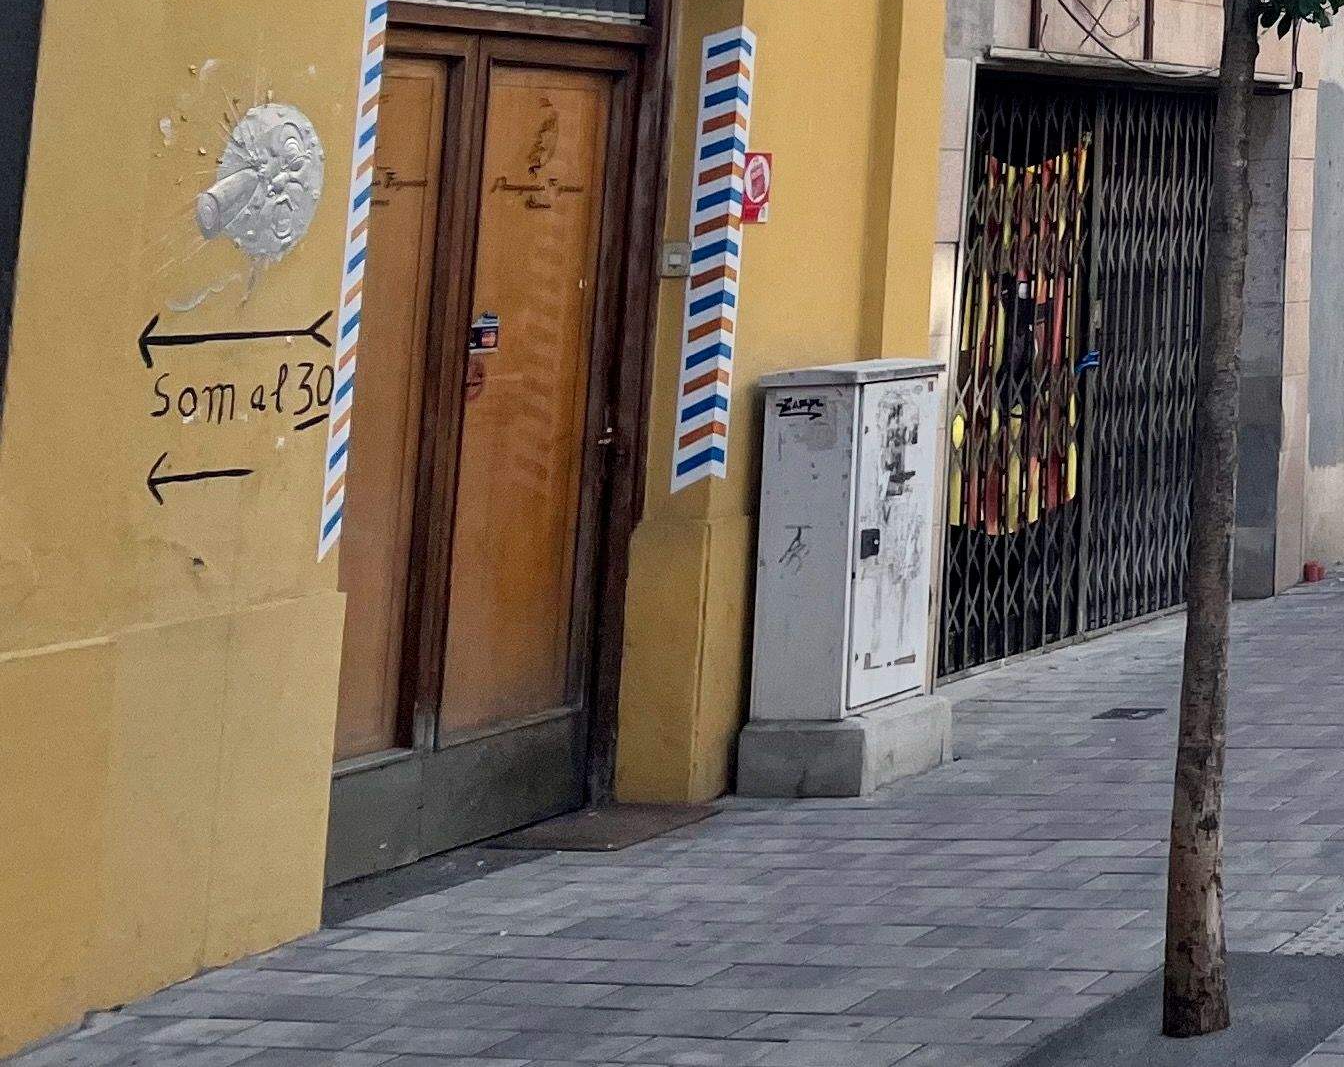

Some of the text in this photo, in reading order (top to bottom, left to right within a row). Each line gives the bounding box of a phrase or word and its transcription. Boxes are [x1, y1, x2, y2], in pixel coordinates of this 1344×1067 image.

[150, 362, 335, 425] Som al 30
